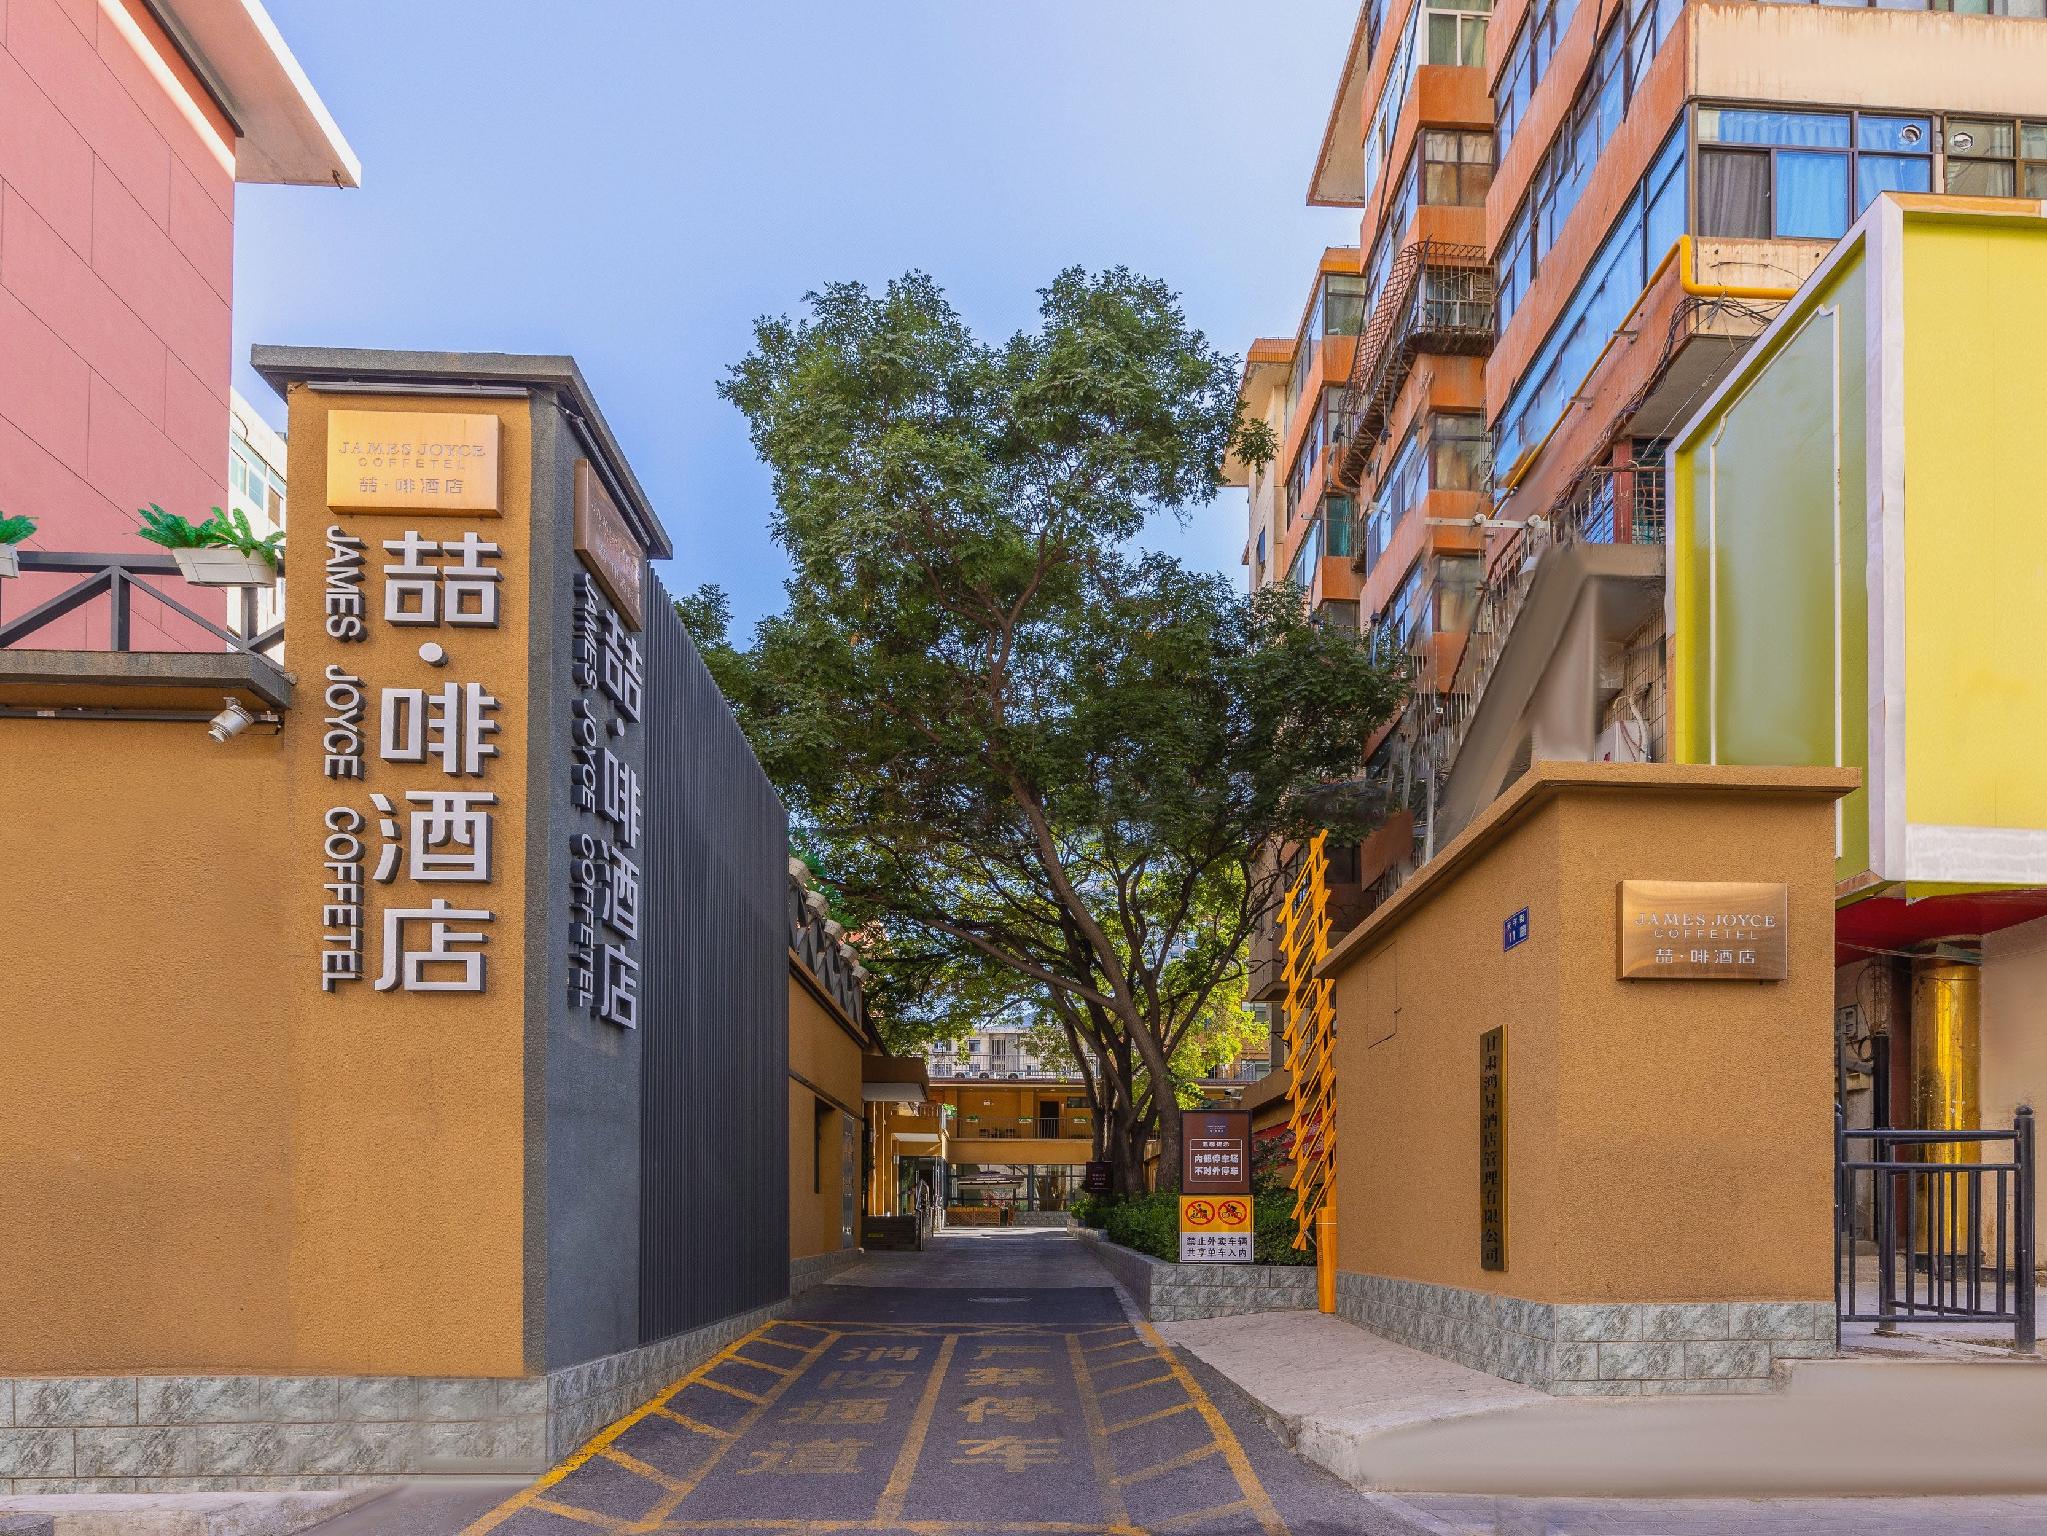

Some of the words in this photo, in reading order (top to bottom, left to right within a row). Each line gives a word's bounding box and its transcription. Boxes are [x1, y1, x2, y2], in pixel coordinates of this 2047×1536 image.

[337, 442, 411, 456] JAMES
[417, 443, 487, 457] JOYCE
[358, 457, 465, 470] COFFETEL
[325, 525, 365, 642] JAMES
[324, 663, 363, 779] JOYCE
[321, 807, 362, 993] COFFETEL
[1634, 912, 1706, 926] JAMES
[1711, 914, 1777, 927] JOYCE
[1654, 929, 1758, 940] COFFETEL
[1186, 1236, 1248, 1246] 禁止外卖车辆
[1187, 1247, 1247, 1258] 共享单车入内
